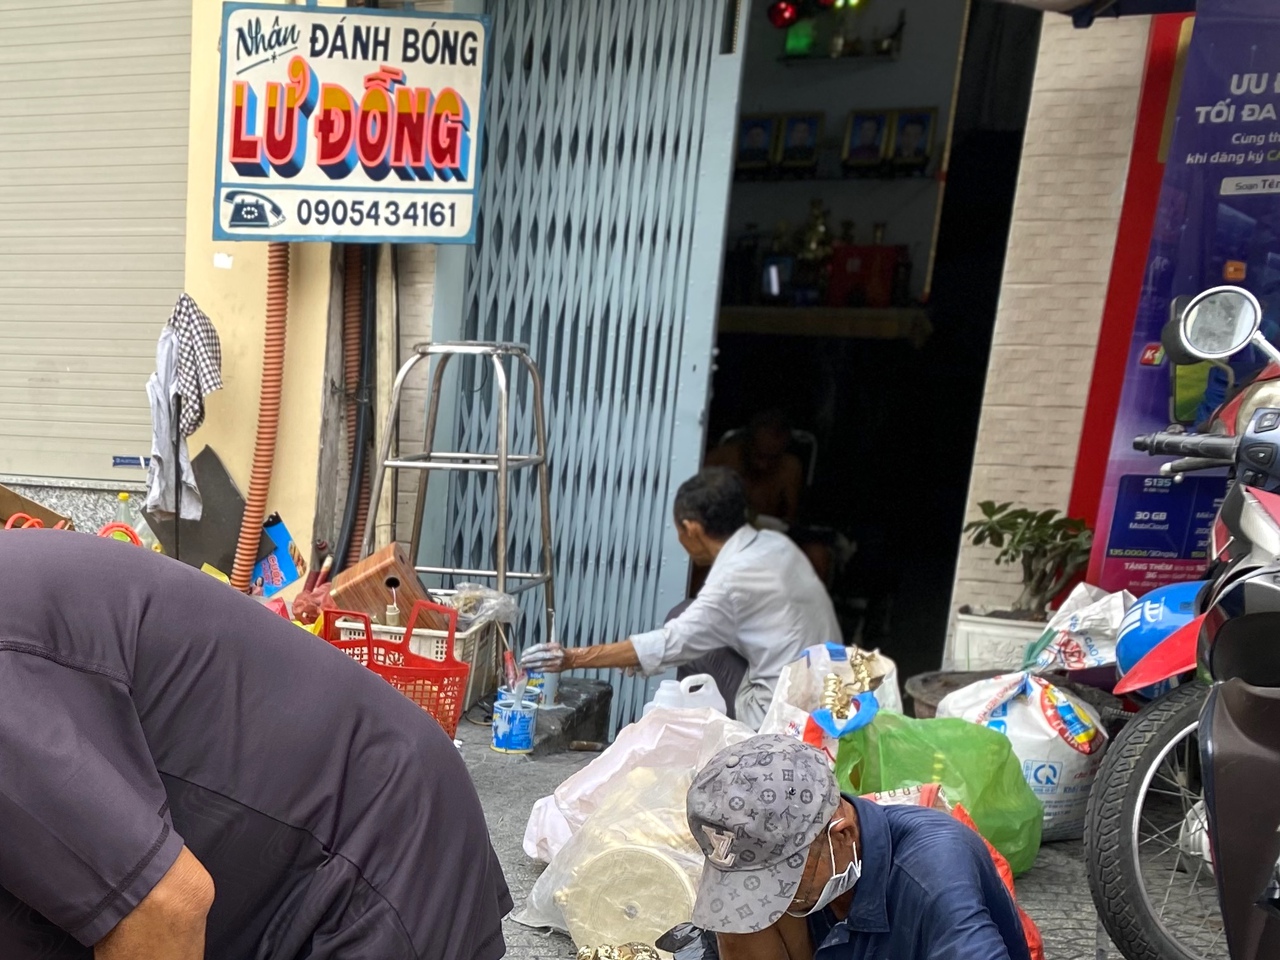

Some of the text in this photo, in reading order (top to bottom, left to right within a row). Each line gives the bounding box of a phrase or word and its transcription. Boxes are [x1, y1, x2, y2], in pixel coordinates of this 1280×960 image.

[310, 17, 391, 62] ĐÁNH
[402, 22, 478, 66] BÓNG
[229, 55, 471, 182] LƯ ĐỒNG
[1195, 98, 1277, 124] TỐI ĐA
[1186, 152, 1207, 164] khi
[297, 199, 456, 227] 0905434161
